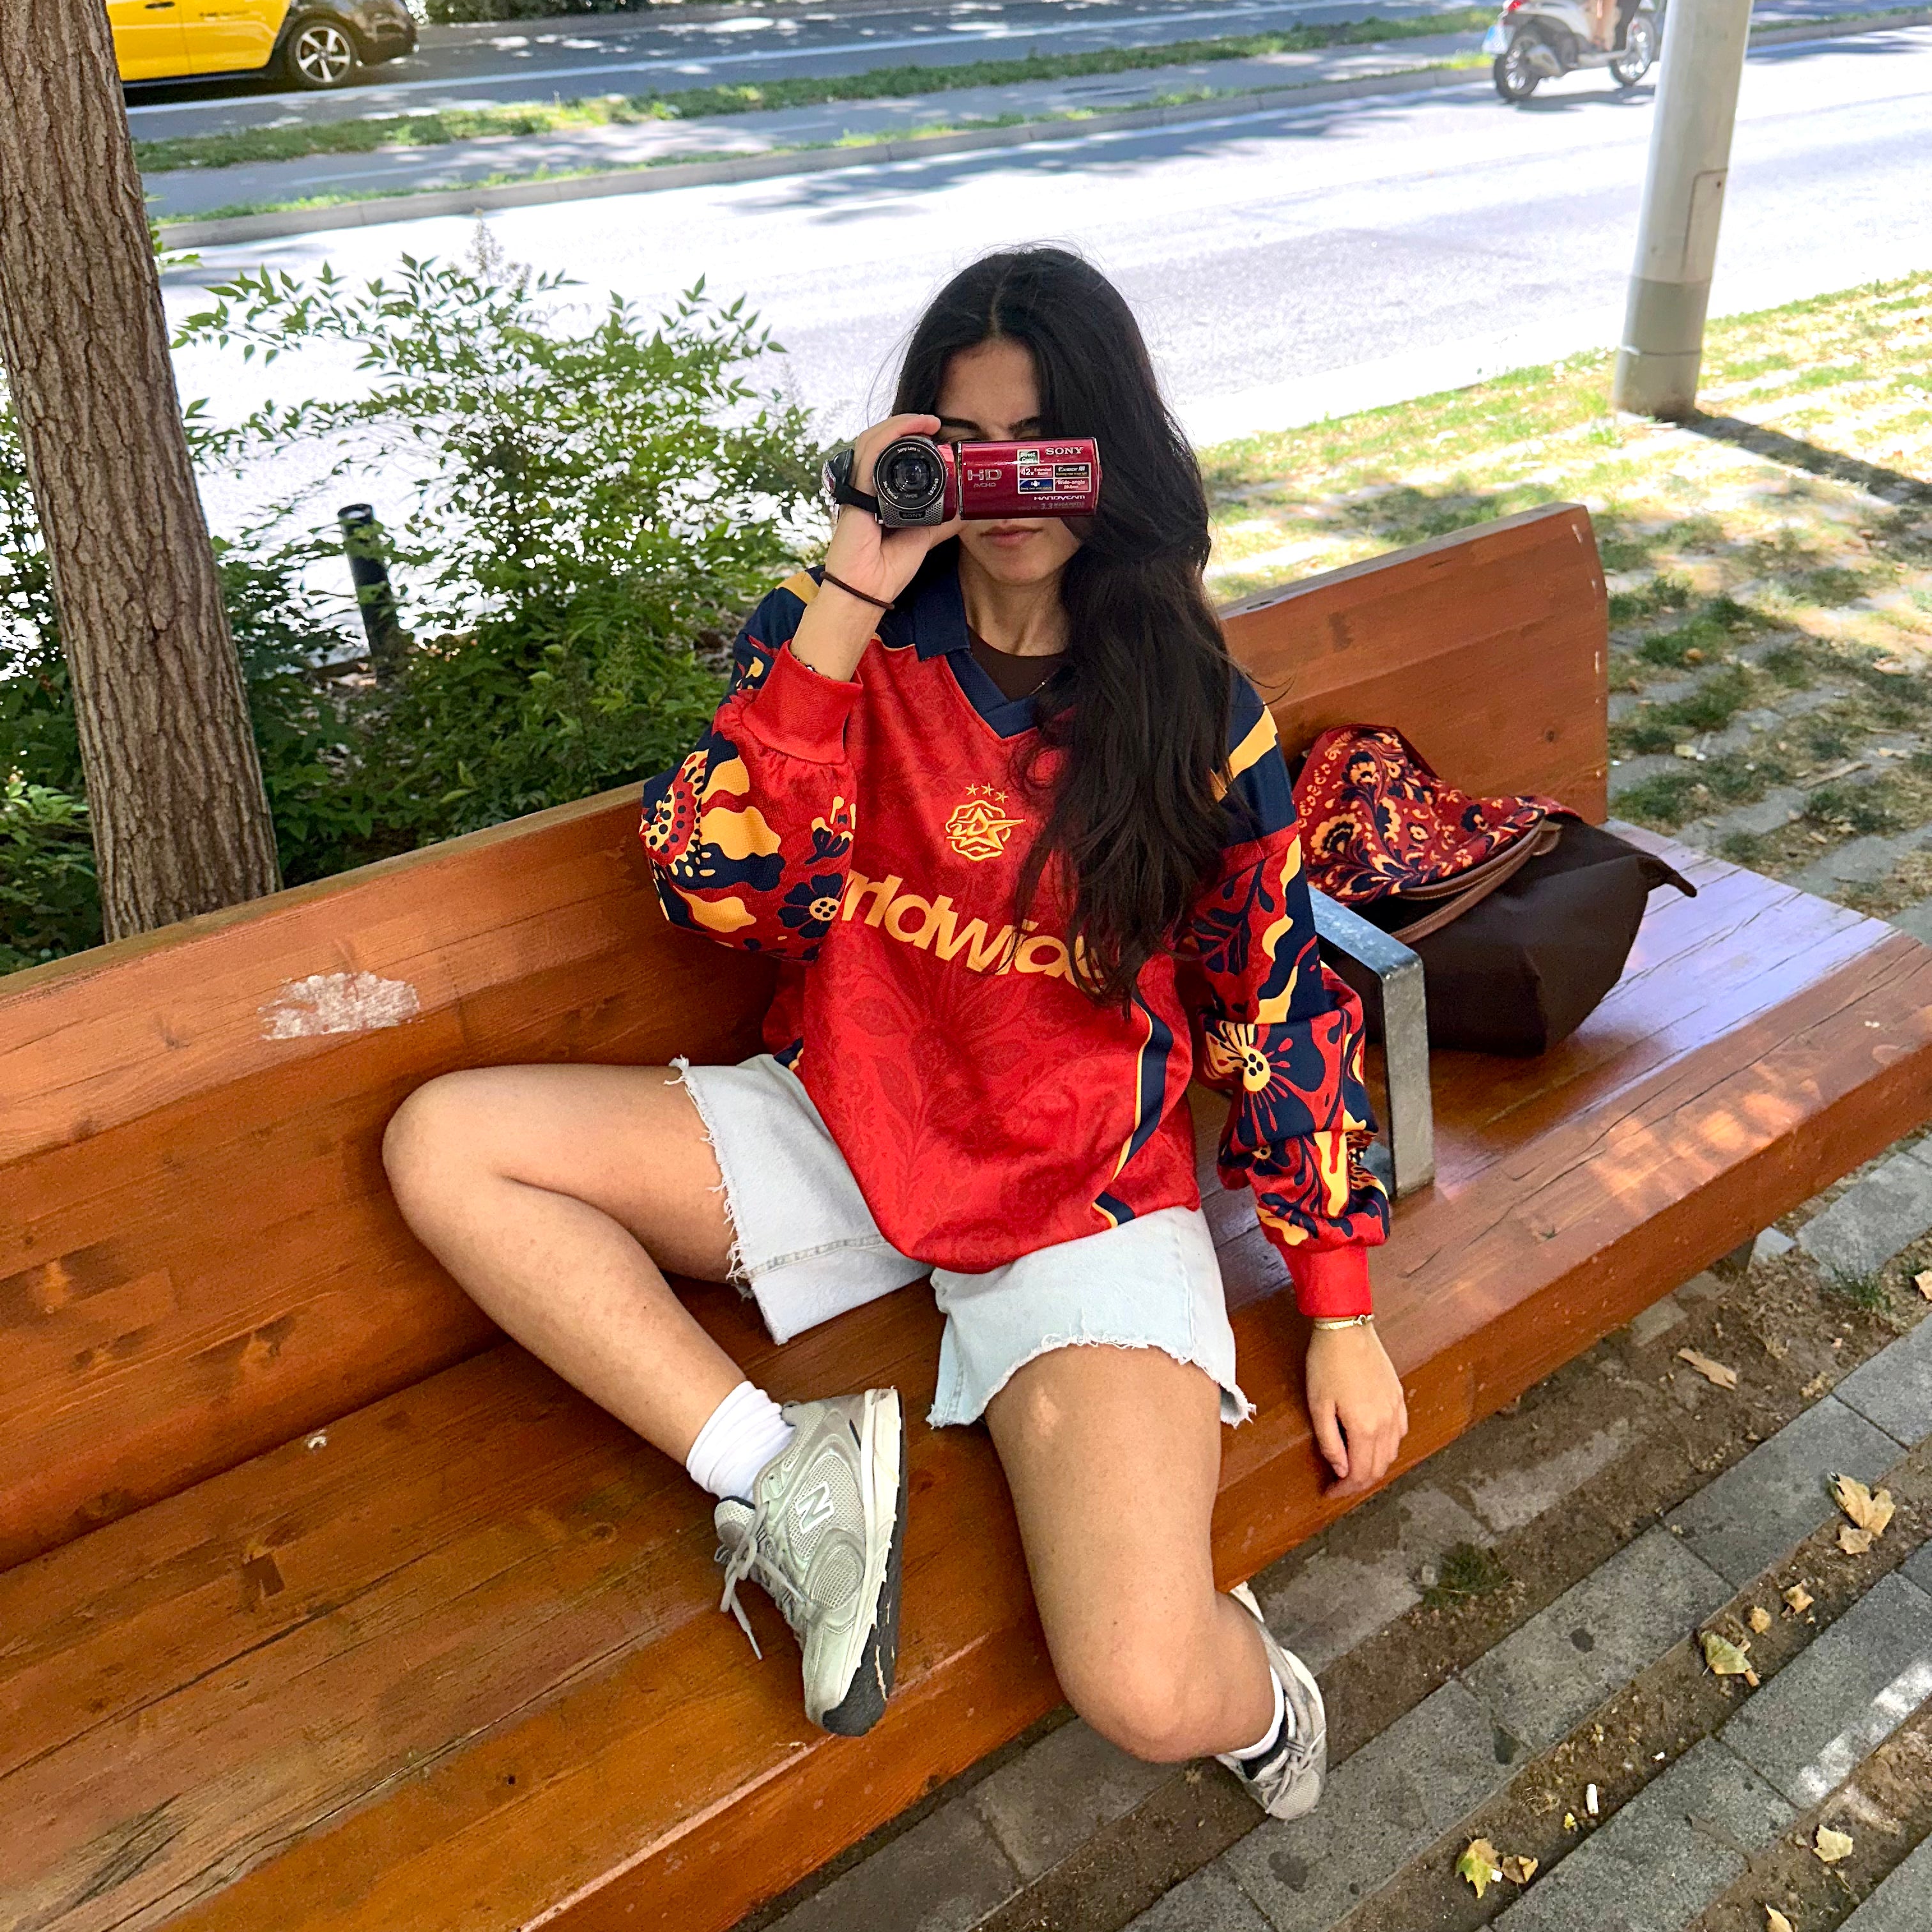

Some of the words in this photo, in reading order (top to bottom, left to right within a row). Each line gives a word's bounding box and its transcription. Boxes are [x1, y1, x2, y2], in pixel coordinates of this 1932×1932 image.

[1045, 447, 1084, 455] SONY
[1021, 468, 1034, 476] 42x
[794, 1480, 835, 1535] N
